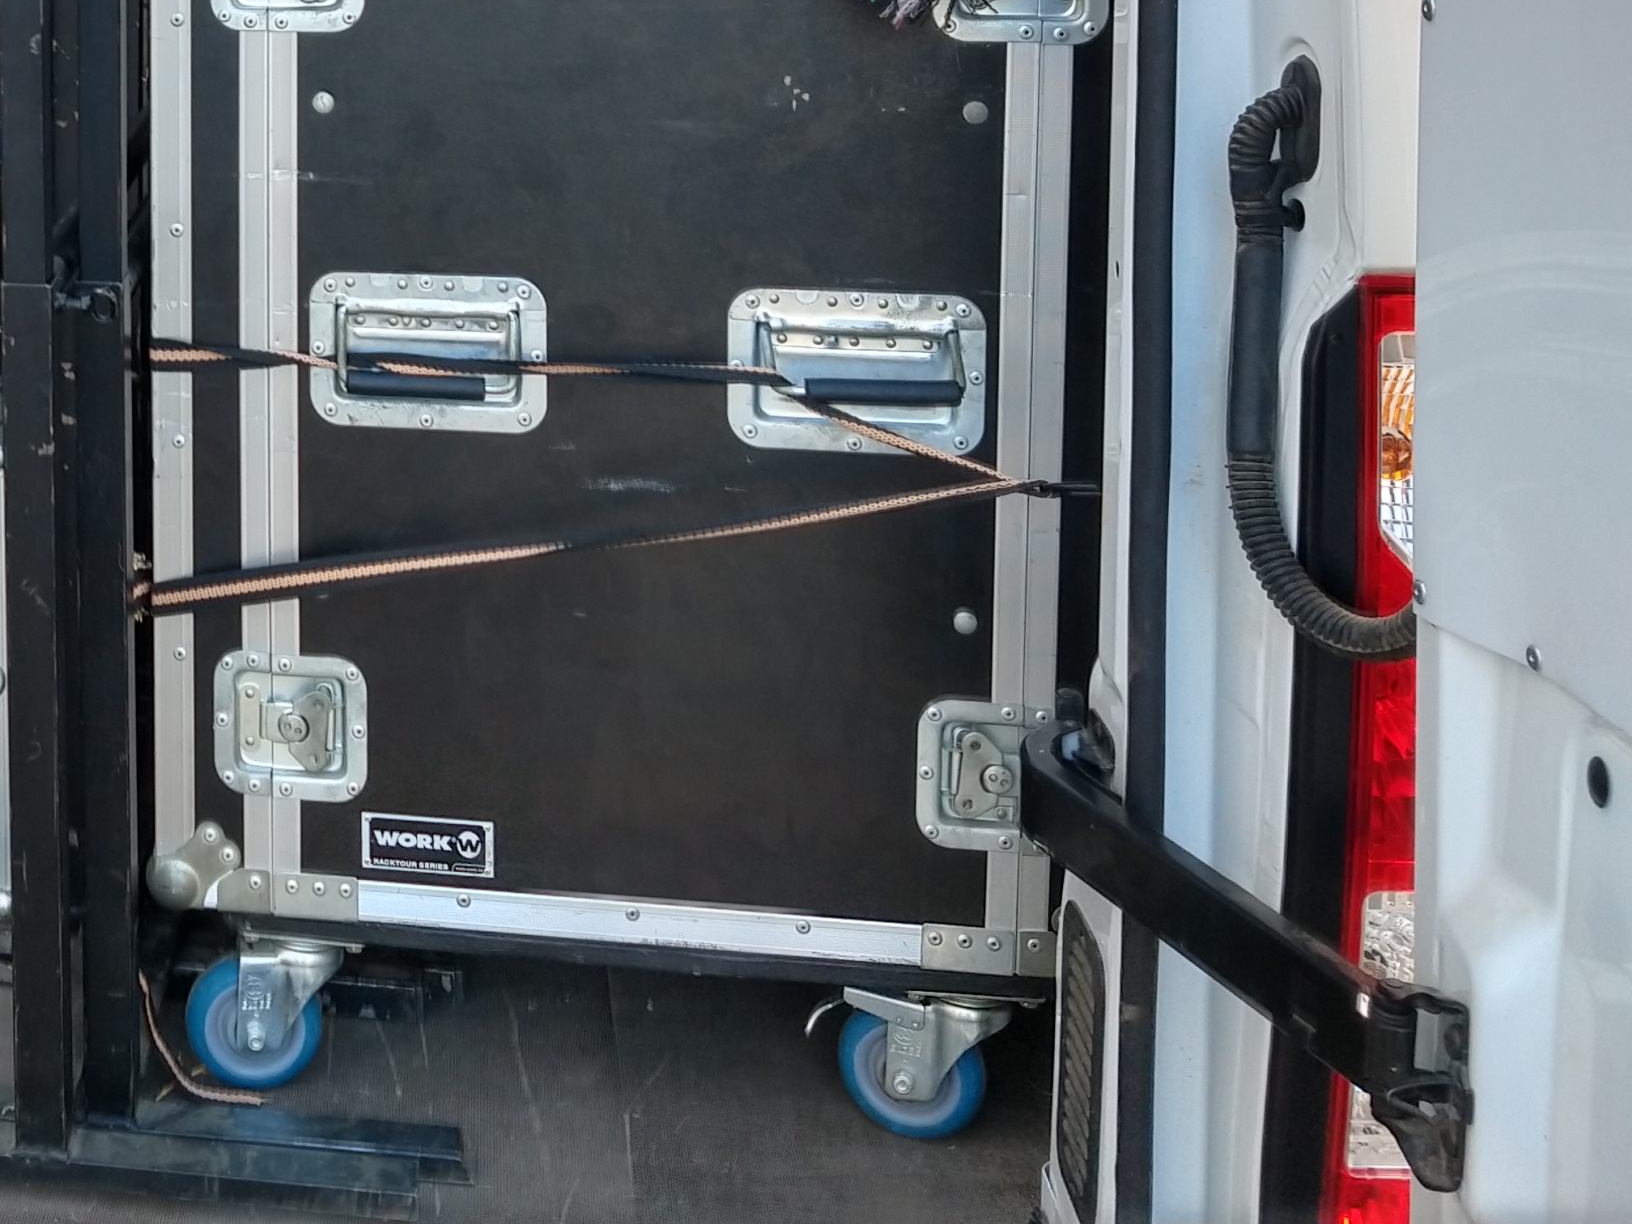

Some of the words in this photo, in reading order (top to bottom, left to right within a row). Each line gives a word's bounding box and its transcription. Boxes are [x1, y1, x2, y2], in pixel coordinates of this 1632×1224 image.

[373, 829, 453, 851] WORK
[373, 858, 418, 869] RACKTOUR
[419, 862, 449, 871] SERIES
